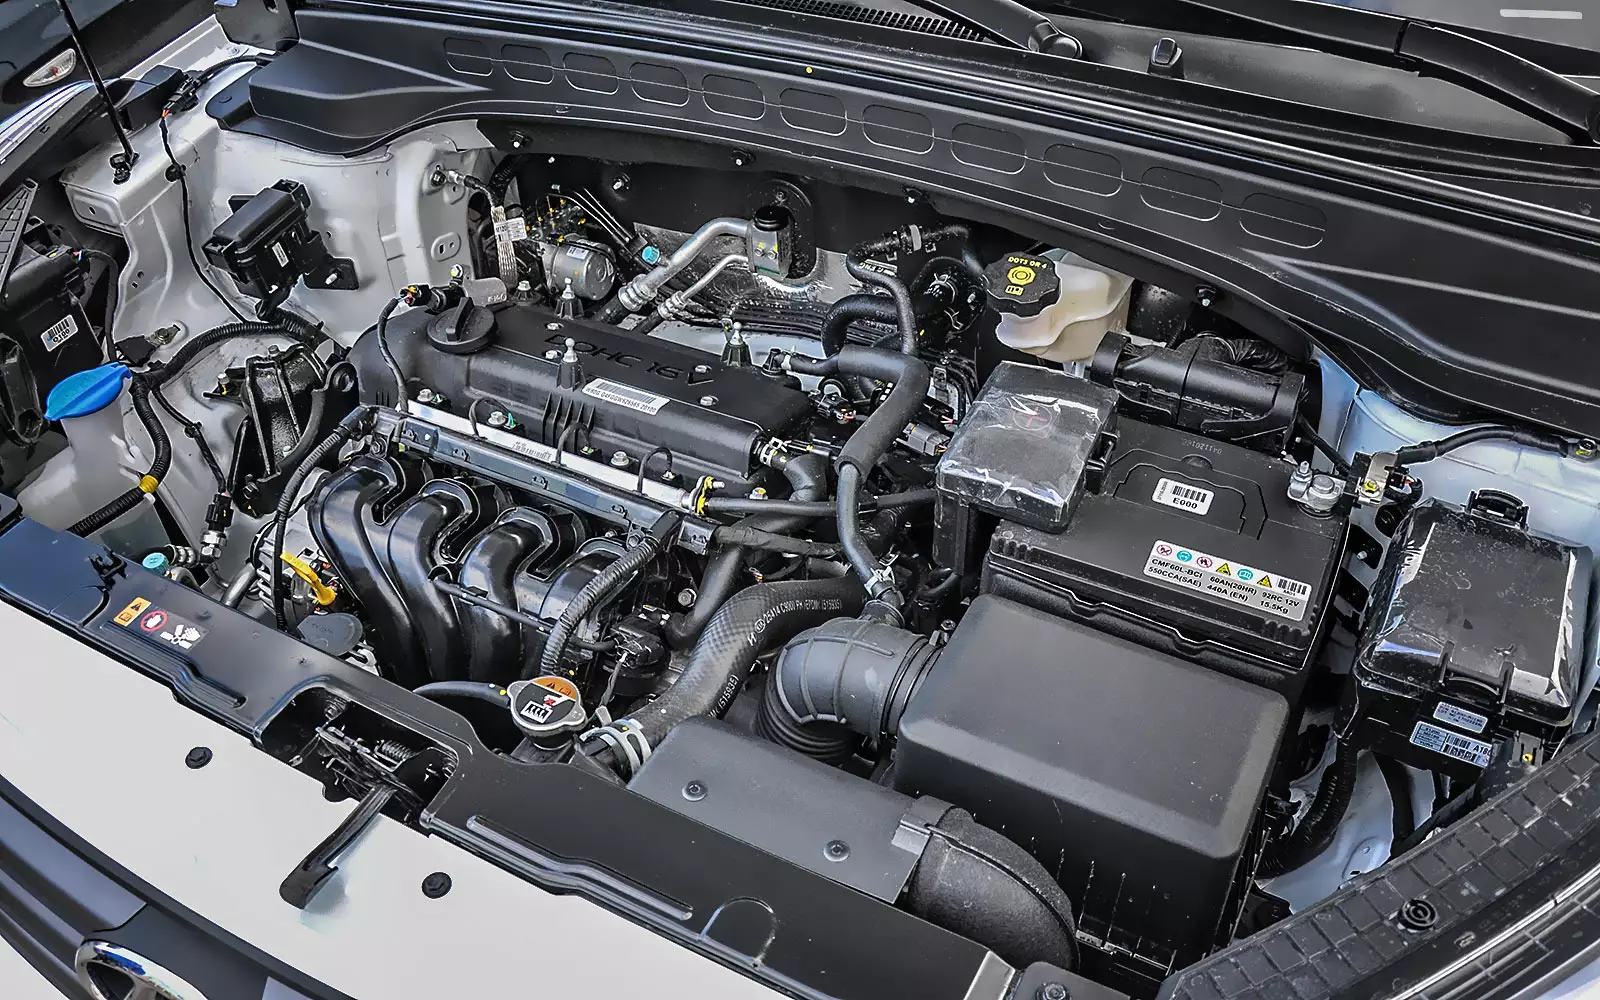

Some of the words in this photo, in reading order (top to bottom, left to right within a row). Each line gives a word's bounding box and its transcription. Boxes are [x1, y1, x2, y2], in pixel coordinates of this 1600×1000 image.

[1007, 256, 1028, 265] DOT3
[1030, 260, 1041, 268] OR
[543, 333, 643, 368] DOHC
[1172, 497, 1198, 509] E000
[1148, 566, 1202, 588] 550CCA(SAE)
[1207, 584, 1228, 595] 440A
[1229, 590, 1249, 602] (EN)
[1151, 558, 1203, 579] CMF60L-BCI
[1210, 576, 1257, 596] 60Ah(20HR)
[1262, 591, 1283, 603] 92RC
[1285, 598, 1300, 607] 12V
